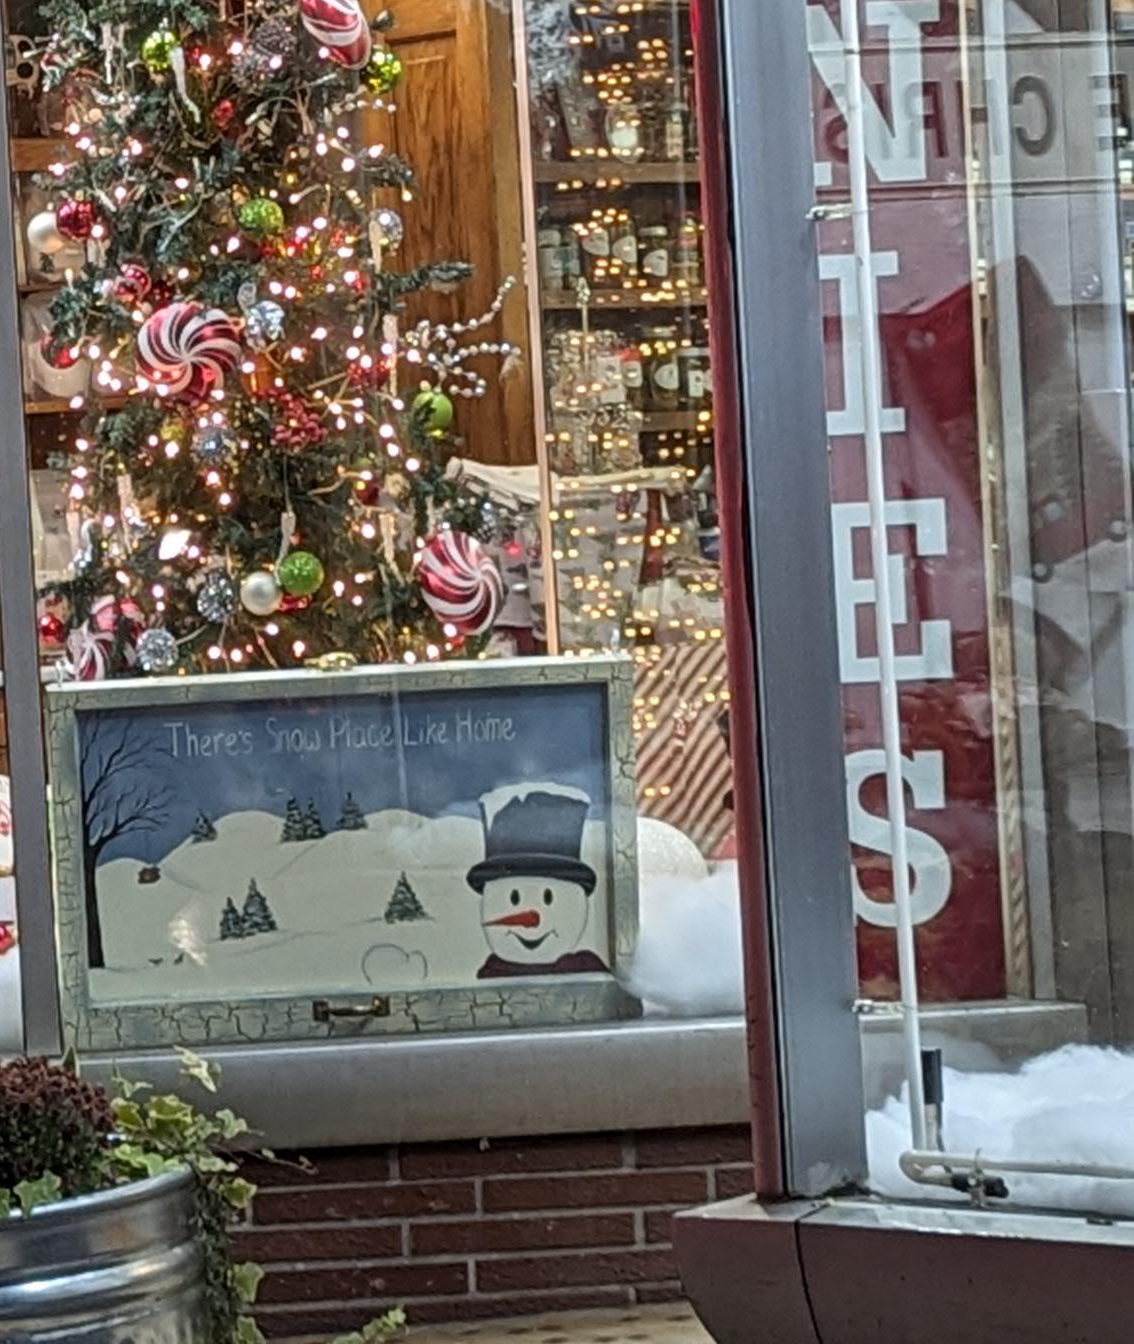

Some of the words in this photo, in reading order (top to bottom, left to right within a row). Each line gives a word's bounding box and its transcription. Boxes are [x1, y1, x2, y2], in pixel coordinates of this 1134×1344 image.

[163, 720, 254, 758] There's
[266, 717, 321, 755] Snow
[328, 719, 394, 750] Place
[402, 713, 449, 747] Like
[455, 710, 517, 744] Home
